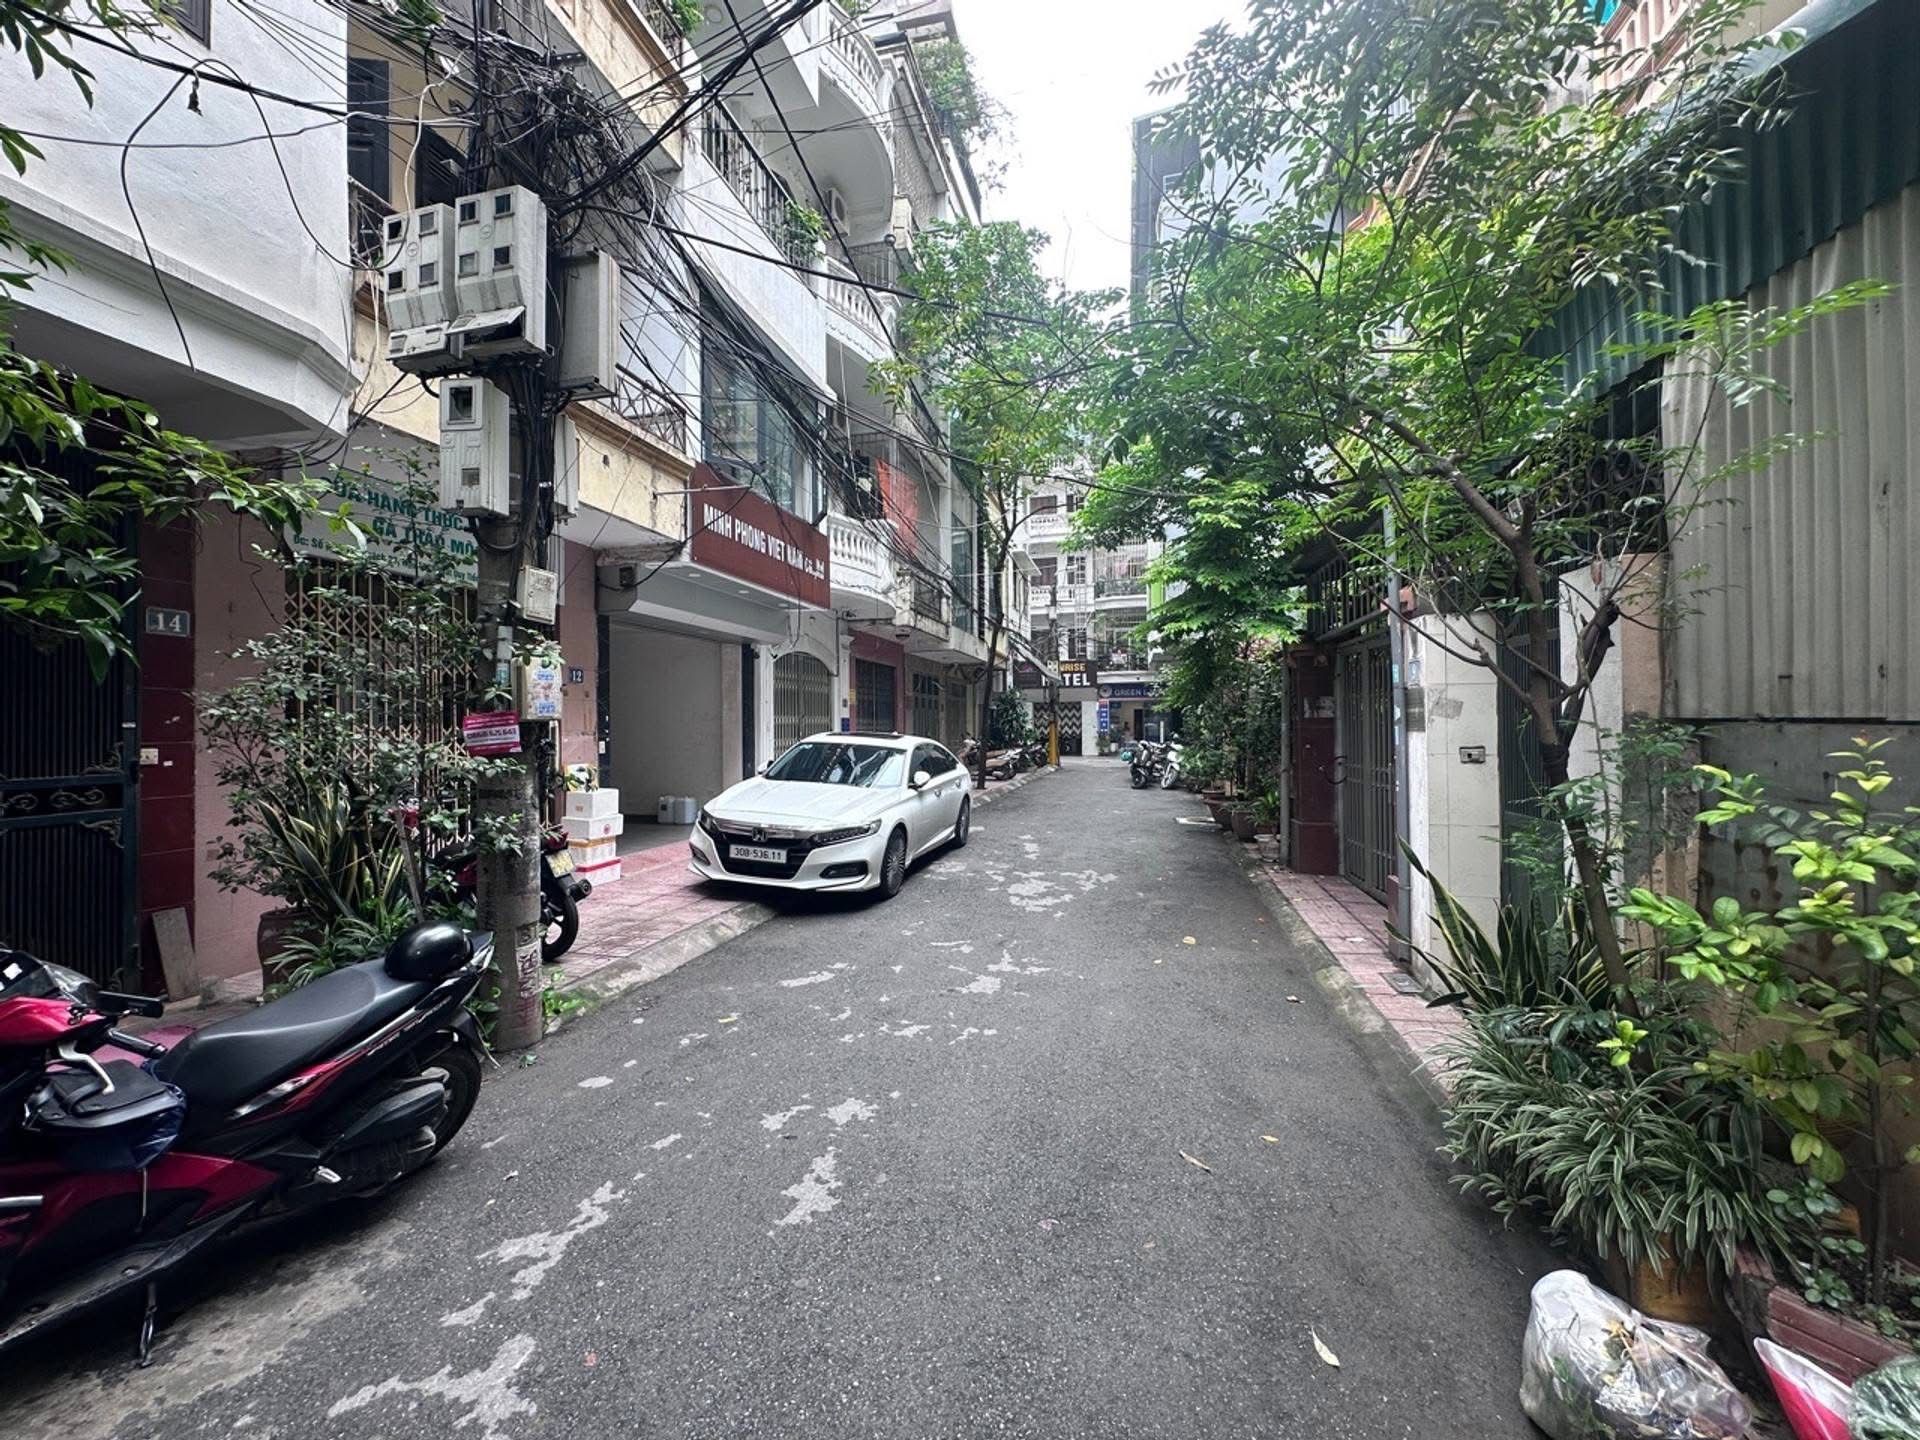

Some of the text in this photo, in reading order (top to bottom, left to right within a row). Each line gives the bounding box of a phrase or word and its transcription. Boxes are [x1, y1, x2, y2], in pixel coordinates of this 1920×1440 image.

[703, 502, 732, 539] MINH
[735, 518, 766, 554] PHONG
[156, 612, 181, 632] 14
[572, 670, 582, 682] 12
